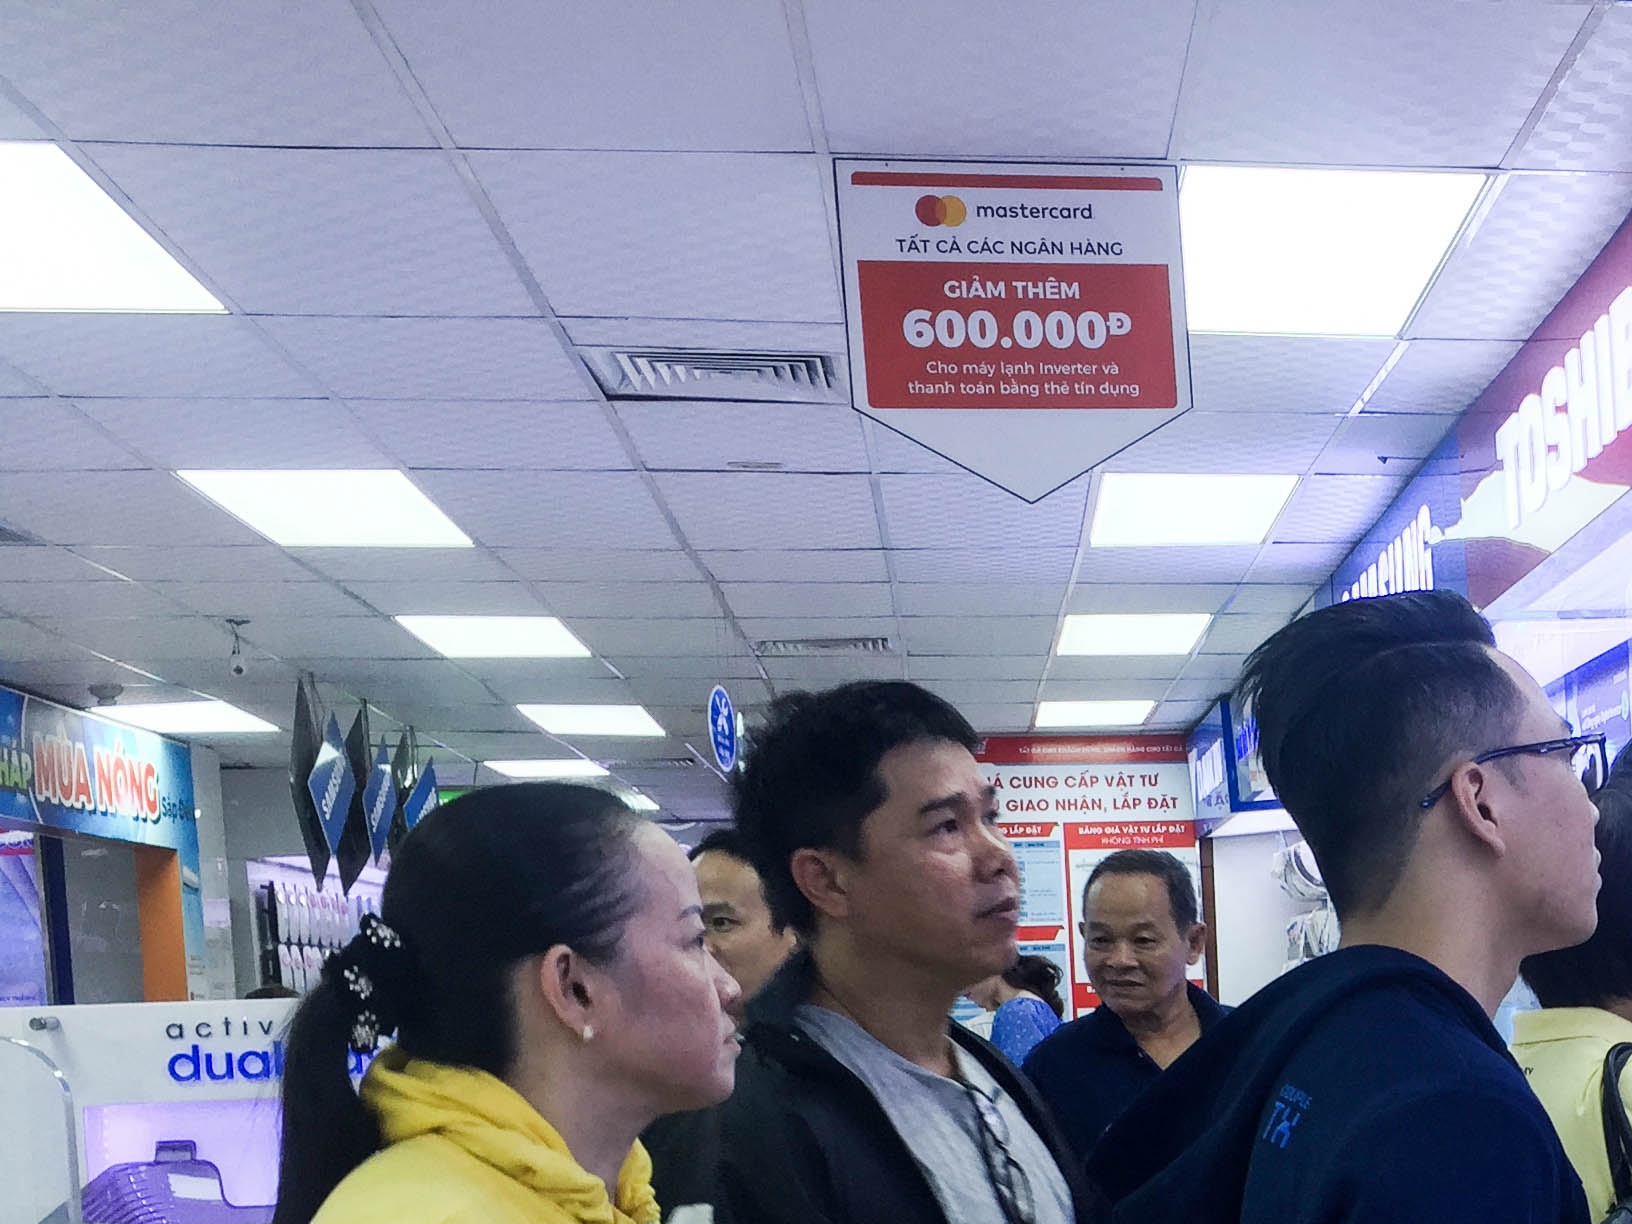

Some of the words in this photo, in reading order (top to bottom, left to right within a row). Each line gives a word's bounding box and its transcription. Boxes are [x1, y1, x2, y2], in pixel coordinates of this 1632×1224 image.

[976, 202, 1093, 220] mastercard
[895, 235, 930, 254] TẤT
[935, 237, 962, 254] CẢ
[967, 236, 1004, 254] CÁC
[1010, 238, 1064, 255] NGÂN
[1070, 238, 1123, 256] HÀNG
[943, 275, 1005, 299] GIẢM
[1012, 276, 1080, 300] THÊM
[925, 360, 958, 375] Cho
[962, 361, 996, 377] máy
[1001, 361, 1035, 377] lạnh
[1039, 362, 1098, 375] Inverter
[1101, 362, 1120, 375] và
[908, 380, 955, 395] thanh
[959, 381, 996, 395] toán
[1000, 378, 1040, 397] bằng
[1074, 381, 1095, 395] tín
[1099, 381, 1140, 397] dụng
[32, 722, 95, 812] MÙA
[92, 740, 162, 825] NÓNG
[1009, 775, 1059, 789] CUNG
[1064, 769, 1098, 788] CẤP
[1104, 771, 1135, 792] VẬT
[1141, 772, 1160, 788] TƯ
[1005, 798, 1050, 813] GIAO
[1113, 791, 1142, 811] LẮP
[1147, 794, 1179, 814] ĐẶT
